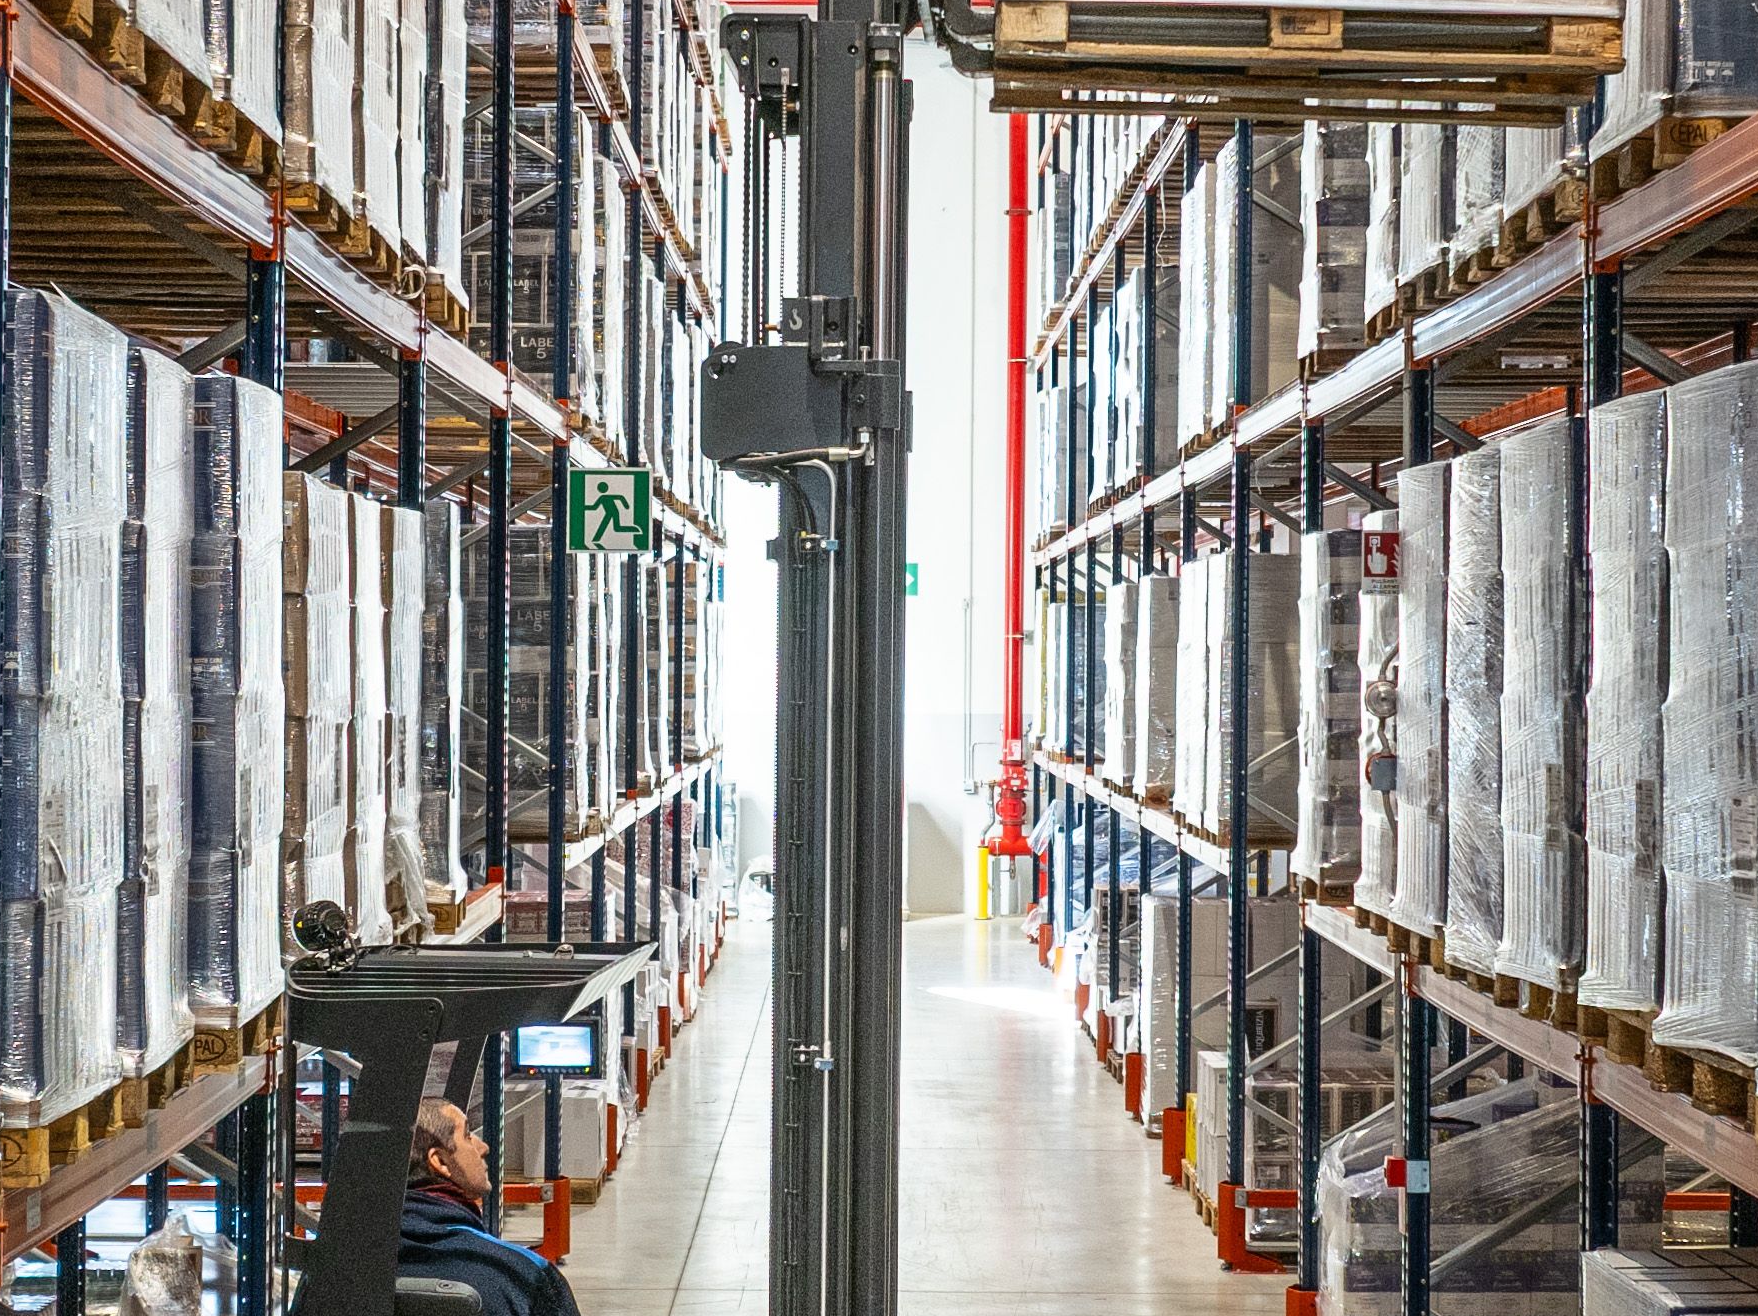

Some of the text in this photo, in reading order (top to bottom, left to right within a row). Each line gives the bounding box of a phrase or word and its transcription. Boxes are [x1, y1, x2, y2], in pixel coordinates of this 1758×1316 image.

[517, 610, 551, 620] LABE
[533, 621, 543, 632] 5
[195, 1039, 220, 1055] PAL
